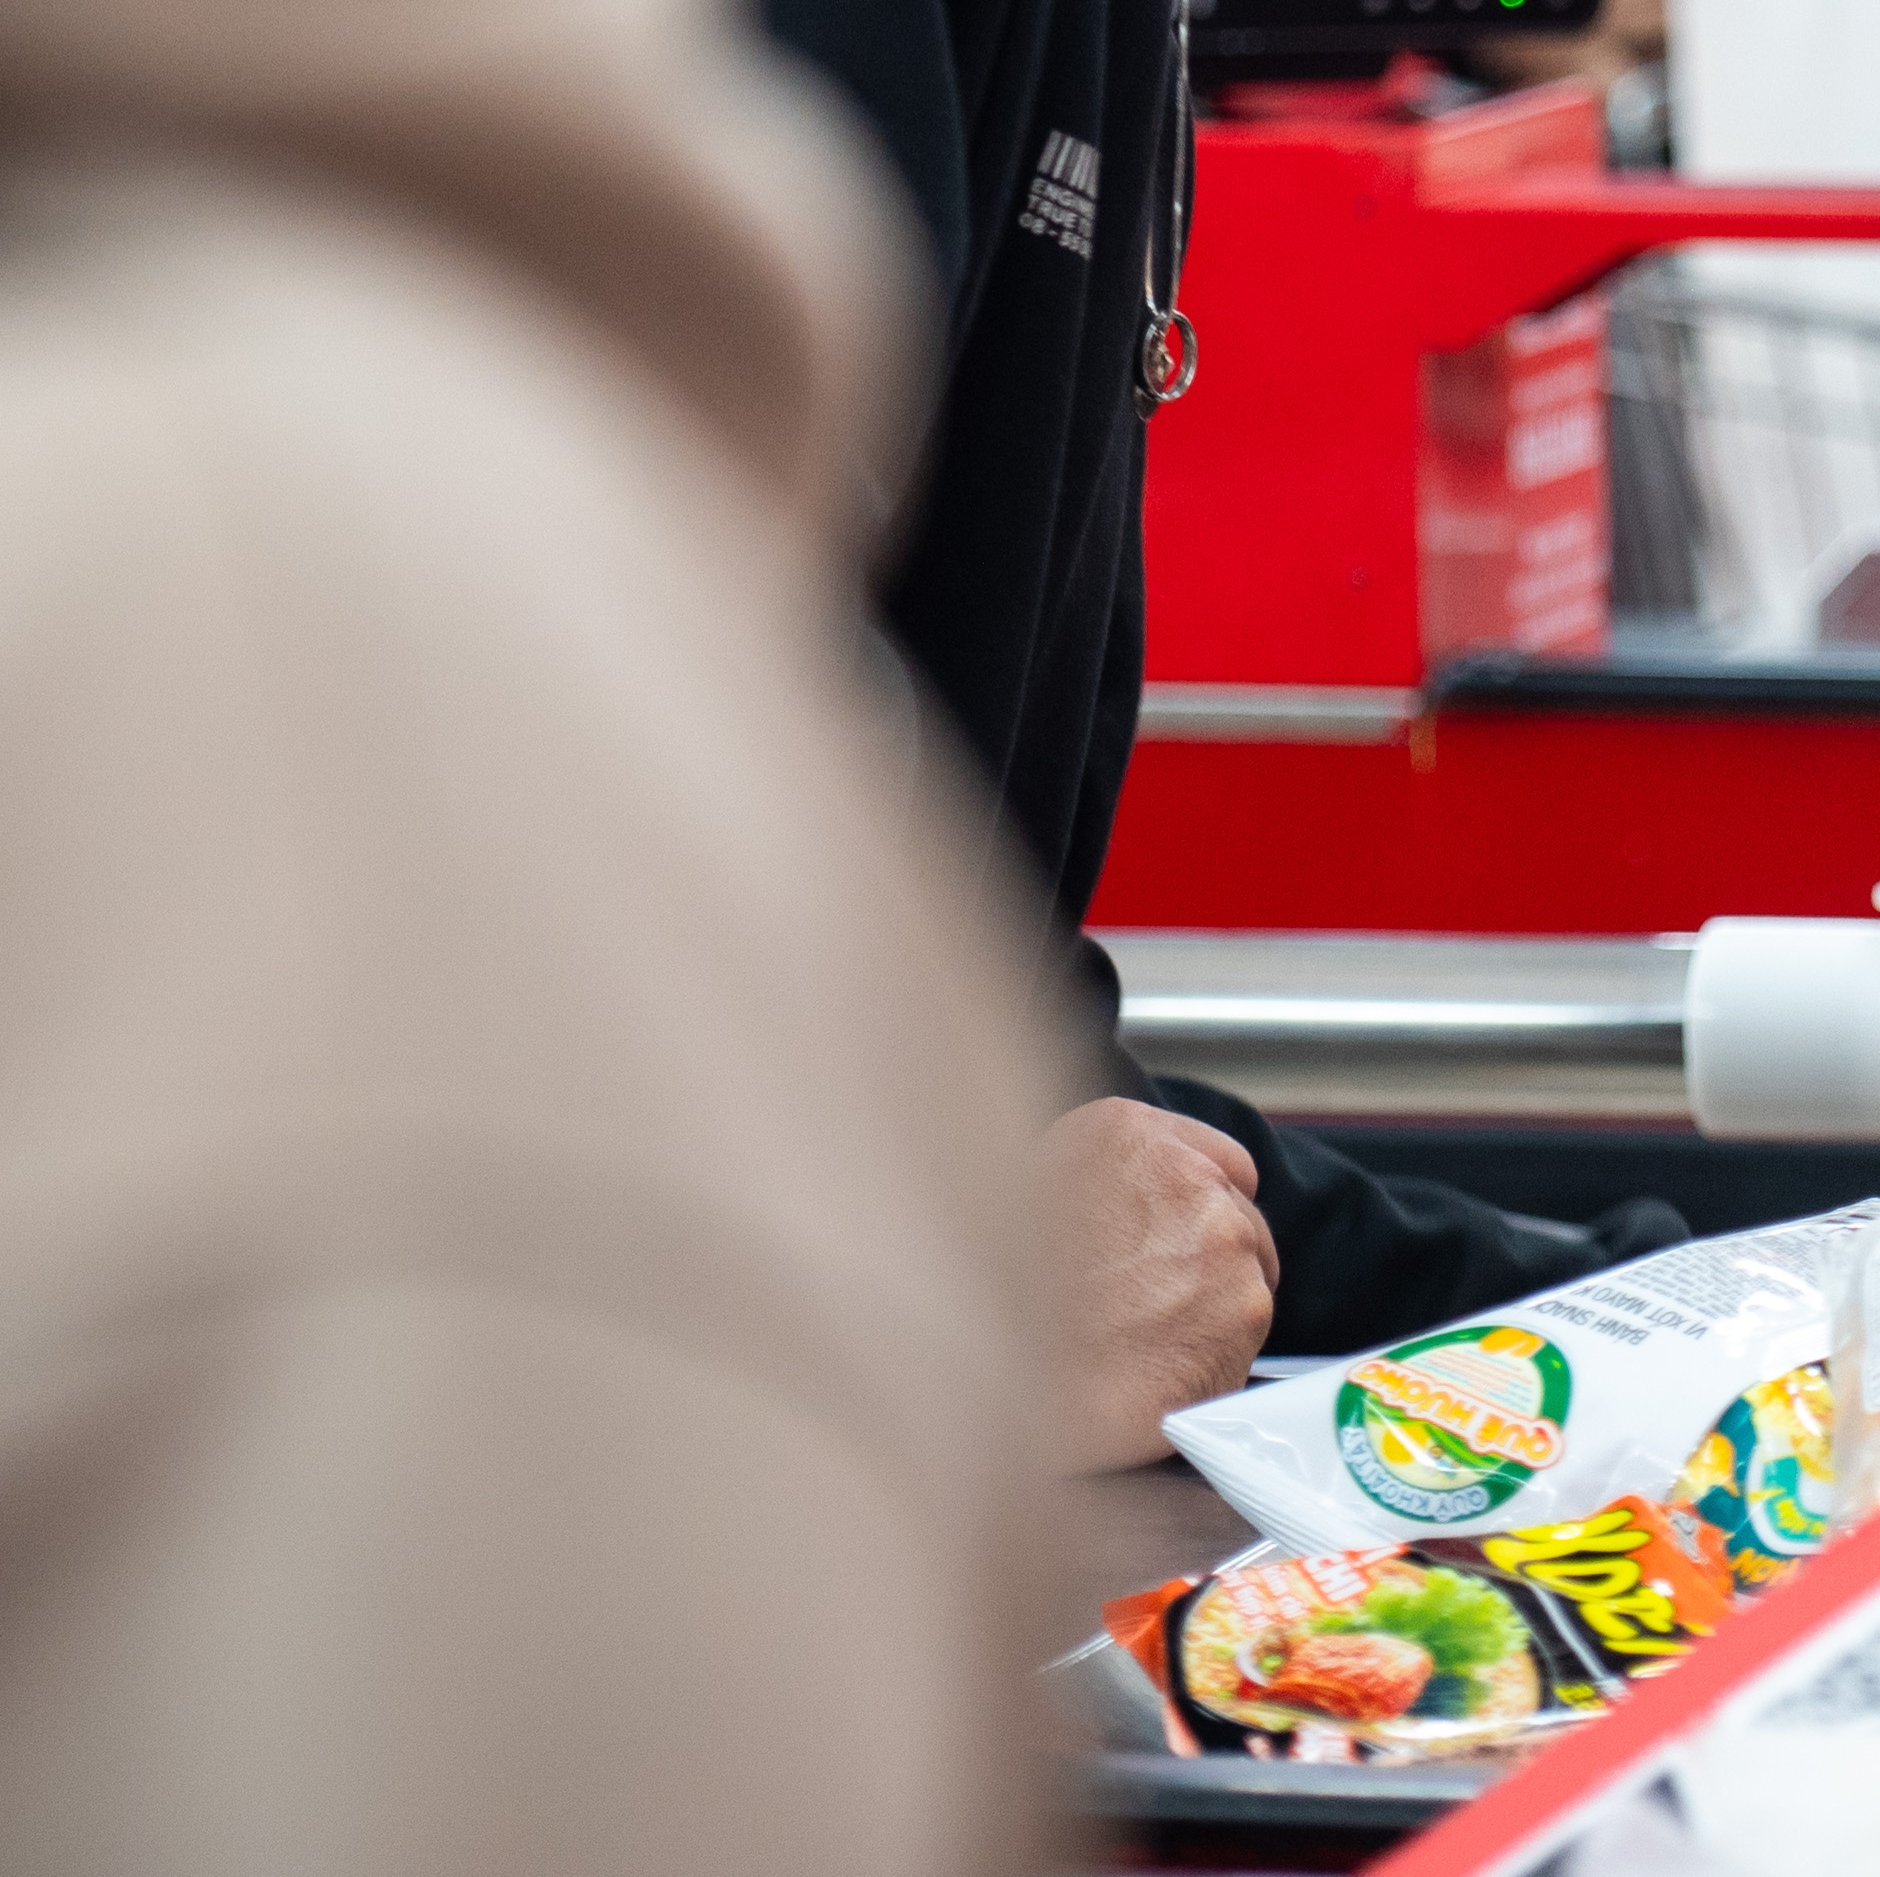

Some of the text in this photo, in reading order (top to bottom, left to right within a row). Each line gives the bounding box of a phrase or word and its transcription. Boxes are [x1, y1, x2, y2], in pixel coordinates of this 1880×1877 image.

[1593, 1287, 1650, 1315] MAYO
[1590, 1317, 1652, 1346] BÁNH
[1355, 1362, 1478, 1429] HƯƠNG
[1474, 1414, 1553, 1461] QUÊ
